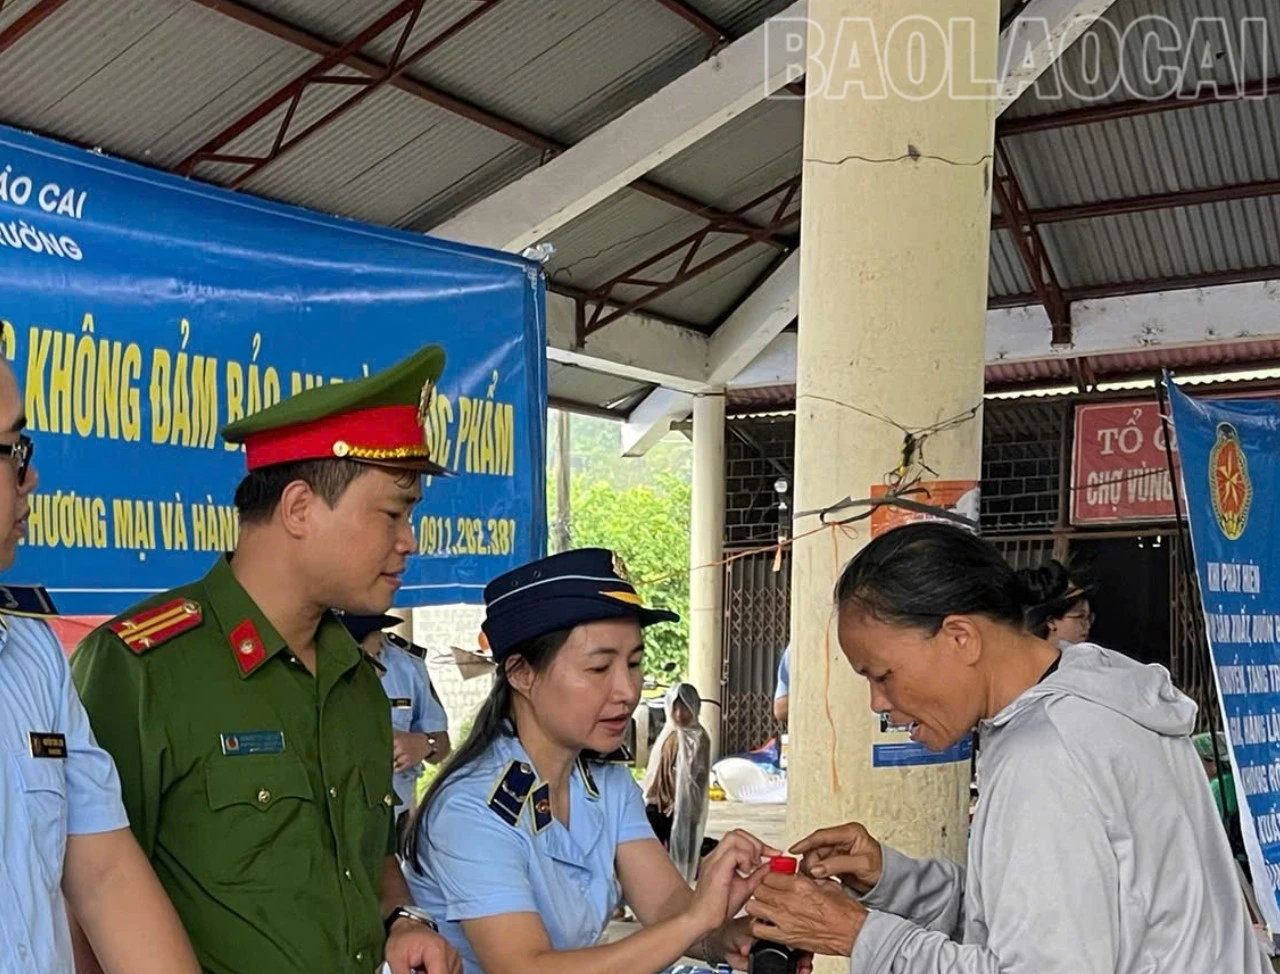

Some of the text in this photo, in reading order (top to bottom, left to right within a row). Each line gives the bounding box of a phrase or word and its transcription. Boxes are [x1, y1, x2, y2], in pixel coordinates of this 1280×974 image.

[38, 183, 88, 219] CAI
[26, 314, 141, 442] KHÔNG
[151, 319, 219, 450] ĐẢM
[453, 370, 514, 476] PHẨM
[1097, 407, 1144, 455] TỔ
[1086, 468, 1123, 512] CHỢ
[113, 499, 156, 561] MẠI
[159, 492, 189, 550] VÀ
